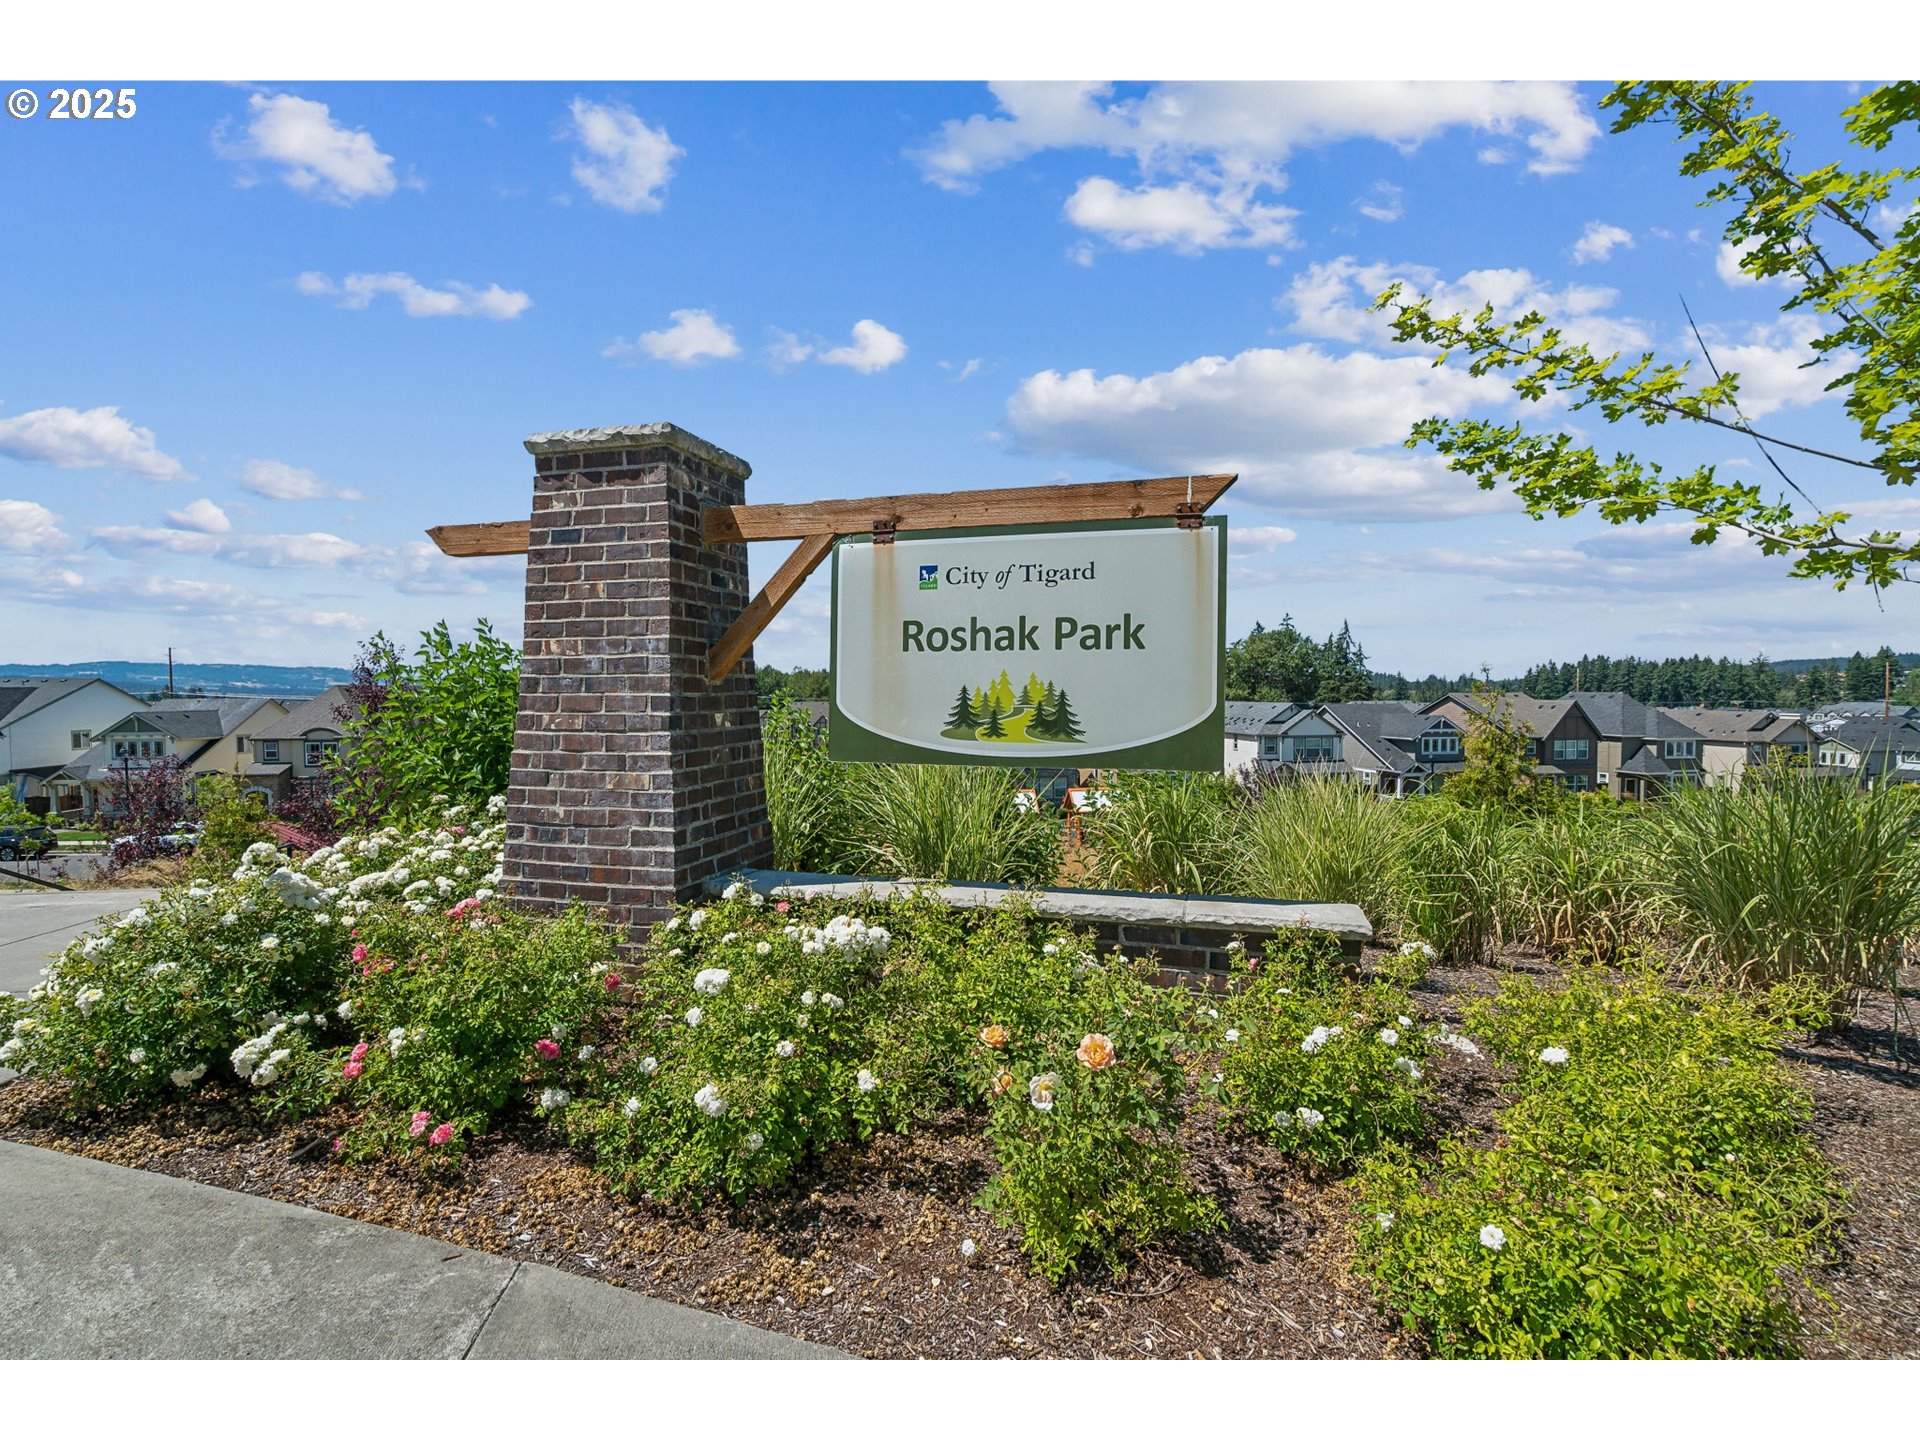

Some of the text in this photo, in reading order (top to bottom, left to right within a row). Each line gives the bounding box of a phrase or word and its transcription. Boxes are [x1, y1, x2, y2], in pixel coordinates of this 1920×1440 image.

[945, 561, 1096, 590] City of Tigard
[902, 612, 1146, 653] Roshak Park
